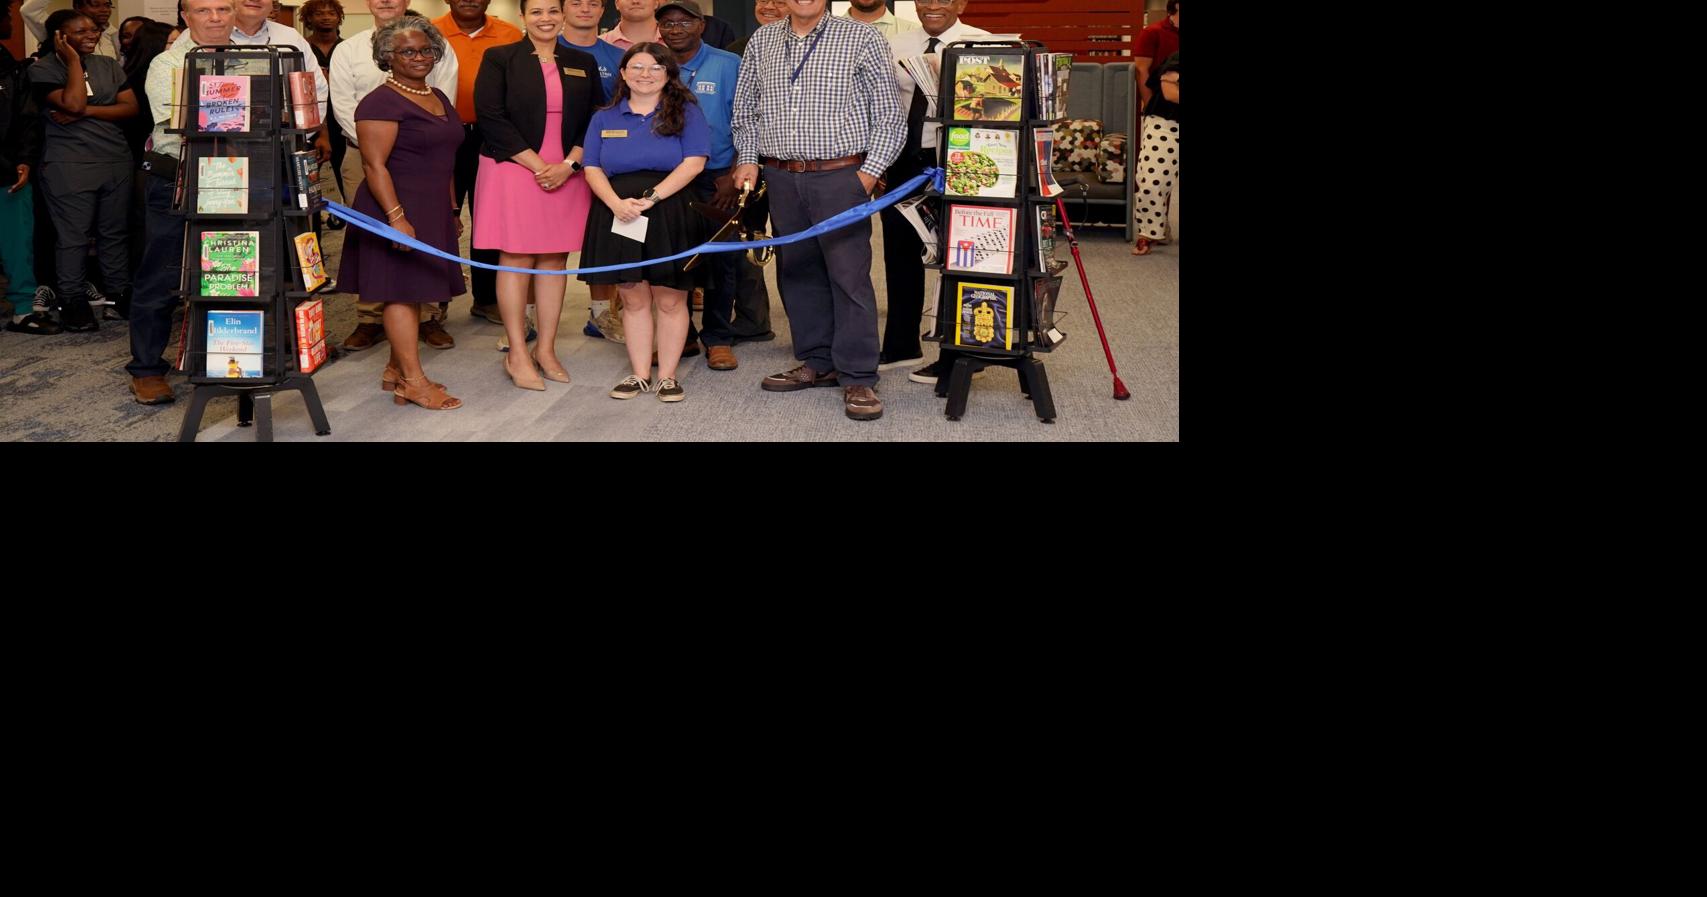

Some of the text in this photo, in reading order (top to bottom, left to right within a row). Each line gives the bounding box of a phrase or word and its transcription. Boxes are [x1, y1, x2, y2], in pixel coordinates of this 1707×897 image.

[958, 55, 991, 65] POST
[206, 98, 239, 108] BROKEN
[960, 215, 1003, 229] TIME
[204, 273, 252, 282] PARADISE
[225, 317, 242, 325] Elin
[213, 326, 257, 335] ilderbrand
